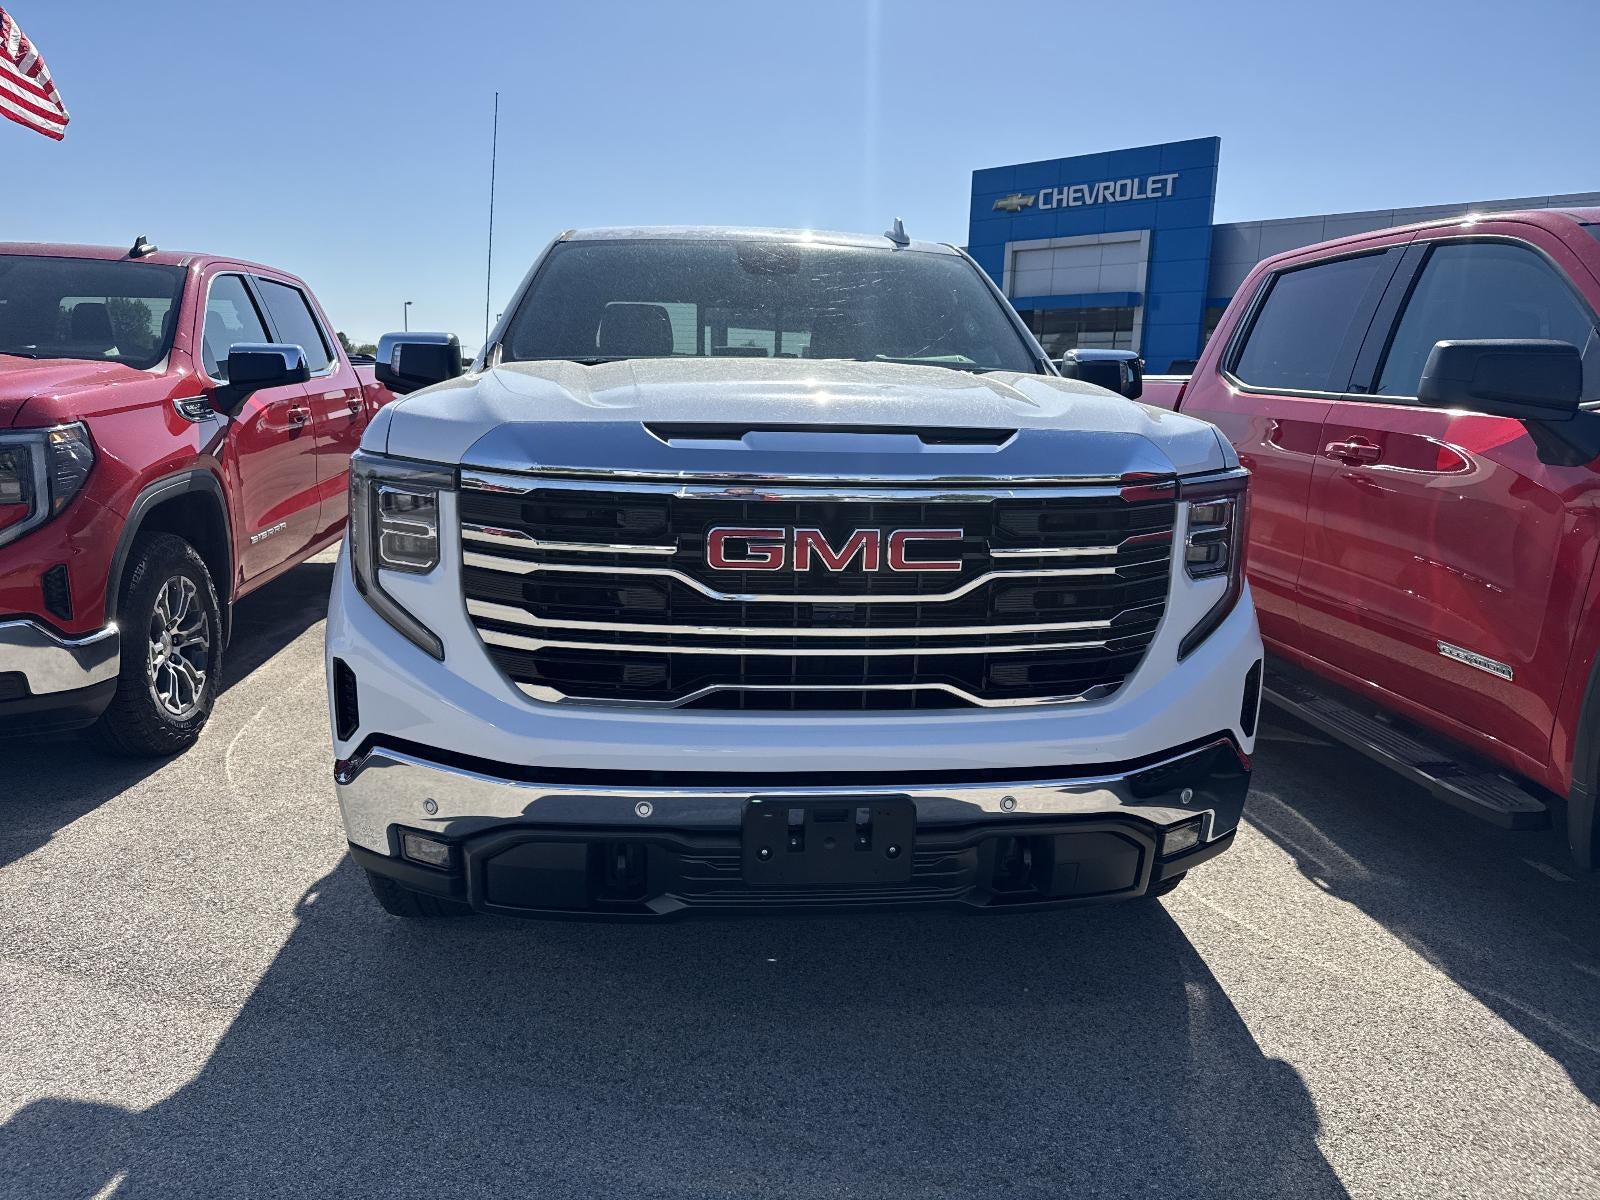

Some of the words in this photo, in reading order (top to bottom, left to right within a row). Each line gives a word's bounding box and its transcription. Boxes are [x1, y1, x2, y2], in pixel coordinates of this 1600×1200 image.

[1038, 172, 1179, 210] CHEVROLET
[250, 521, 287, 544] SIERRA
[707, 526, 964, 572] GMC
